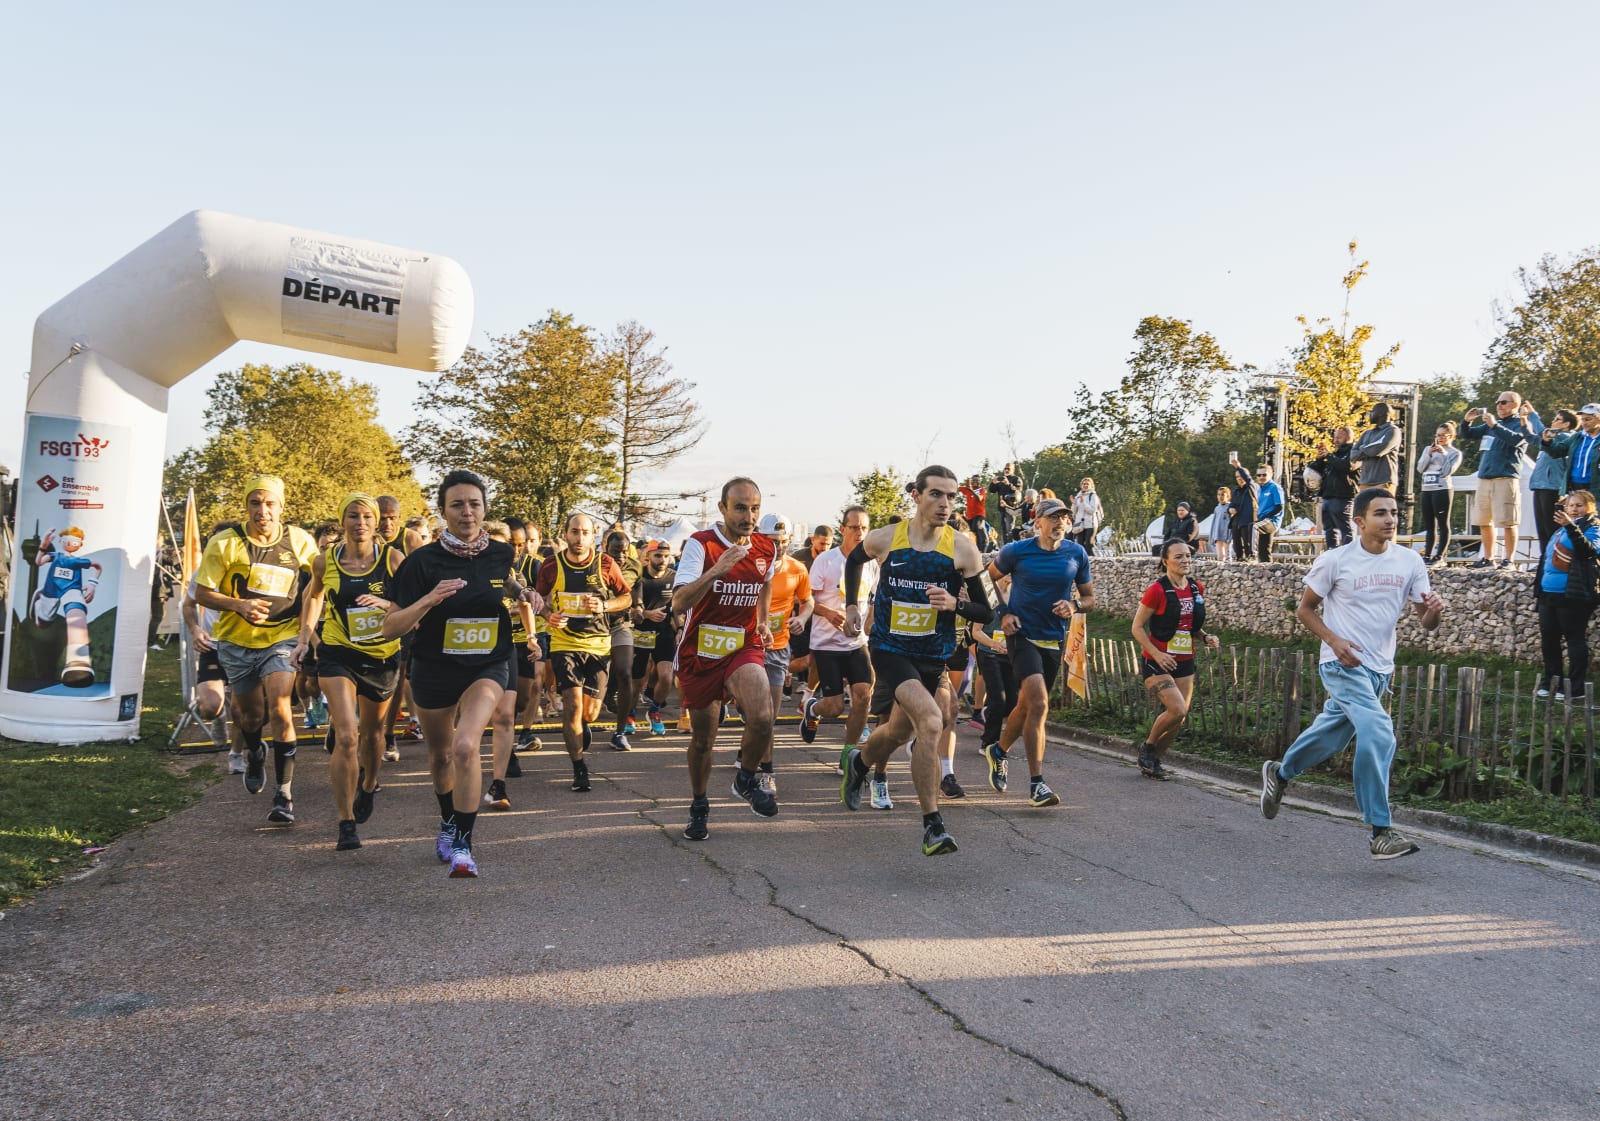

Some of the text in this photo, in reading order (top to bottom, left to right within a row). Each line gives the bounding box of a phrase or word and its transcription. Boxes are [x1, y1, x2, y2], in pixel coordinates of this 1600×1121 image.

[282, 277, 401, 316] DÉPART
[40, 441, 100, 458] FSGT 93
[62, 482, 100, 492] Ensemble
[712, 579, 764, 595] Emirate
[888, 576, 897, 587] CA
[897, 578, 938, 590] MONTRE
[1353, 573, 1405, 591] LOS ANGELES
[719, 594, 734, 606] FLY
[897, 611, 932, 627] 227
[451, 627, 491, 643] 360
[703, 633, 737, 651] 576
